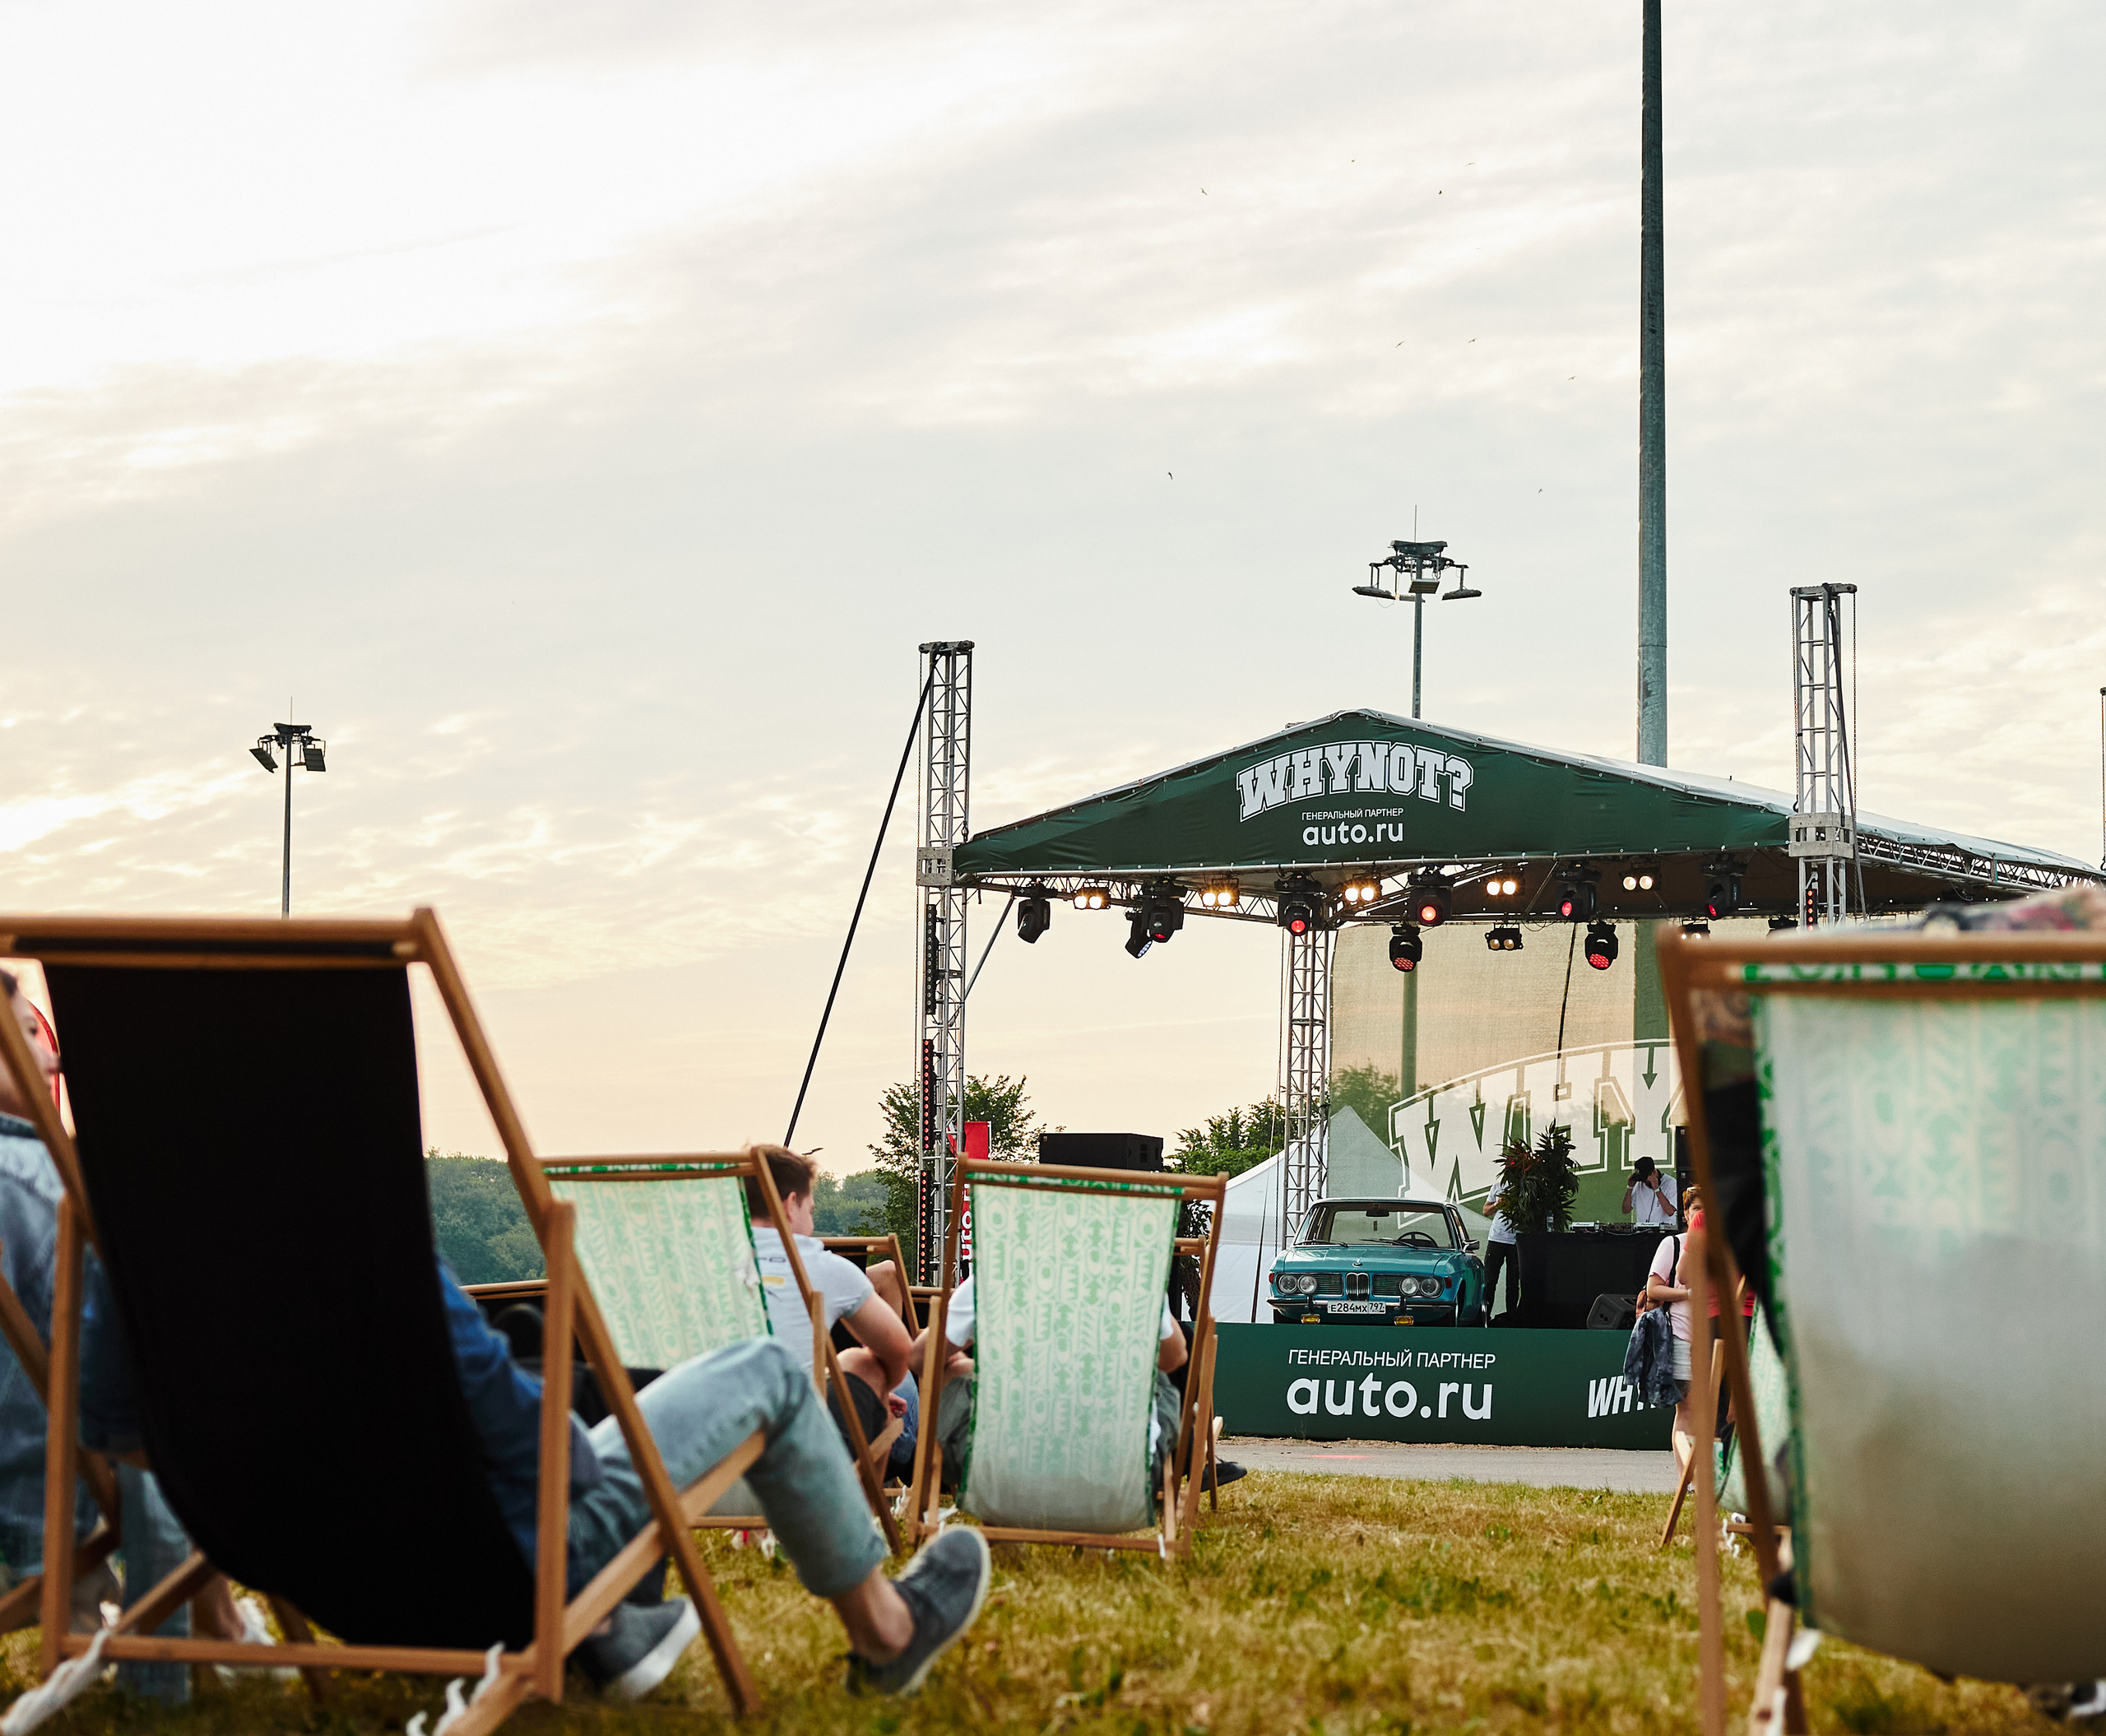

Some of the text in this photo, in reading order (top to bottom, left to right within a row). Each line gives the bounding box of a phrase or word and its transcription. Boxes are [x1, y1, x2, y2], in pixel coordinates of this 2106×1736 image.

[1236, 740, 1474, 823] WHYNOT?
[1301, 807, 1404, 821] ГЕНЕРАЛЬНЫЙ ПАРТНЕР
[1302, 820, 1403, 846] auto.ru
[1288, 1348, 1496, 1369] ГЕНЕРАЛЬНЫЙ ПАРТНЕР
[1287, 1372, 1493, 1420] auto.ru
